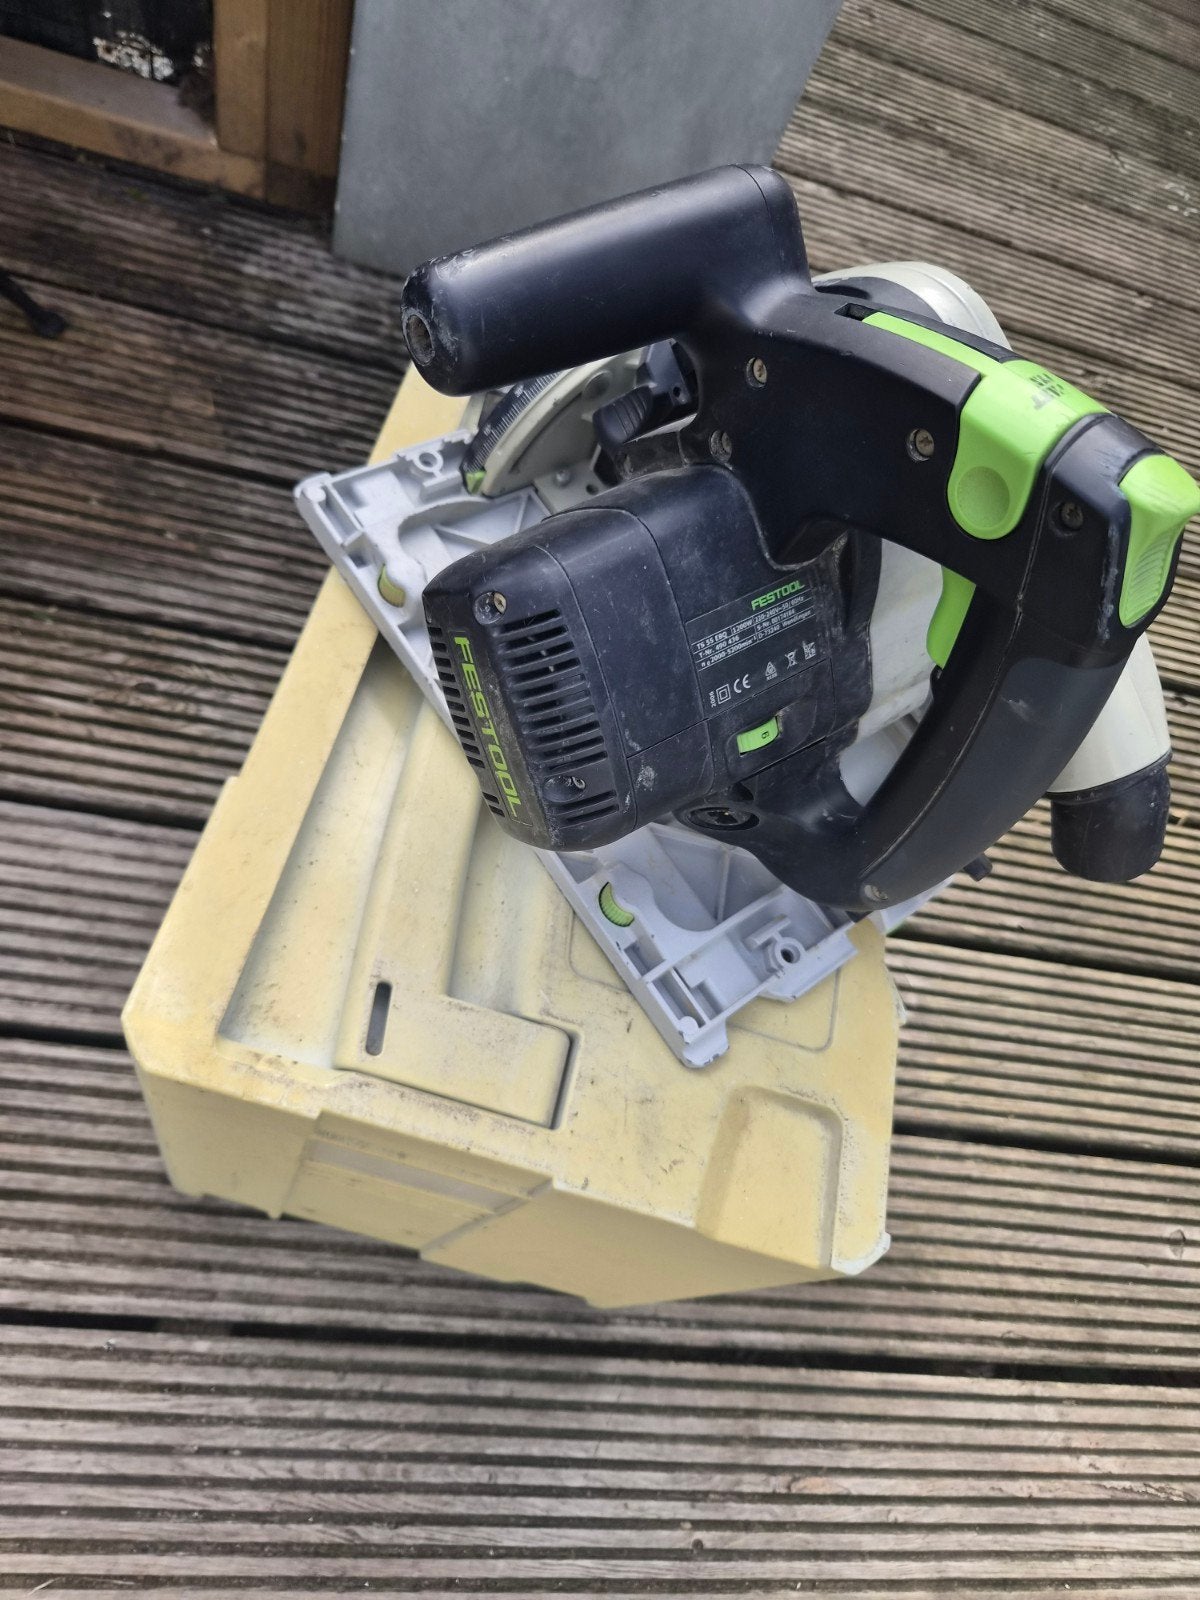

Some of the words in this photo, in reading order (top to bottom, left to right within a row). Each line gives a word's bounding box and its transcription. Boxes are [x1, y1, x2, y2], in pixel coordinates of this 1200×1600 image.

[751, 580, 805, 611] FESTOOL
[706, 637, 714, 646] 55
[715, 632, 728, 644] EBQ
[732, 620, 753, 634] 1200W
[715, 640, 727, 650] 490
[728, 635, 740, 646] 436
[733, 674, 751, 693] CE
[454, 637, 521, 817] FESTOOL
